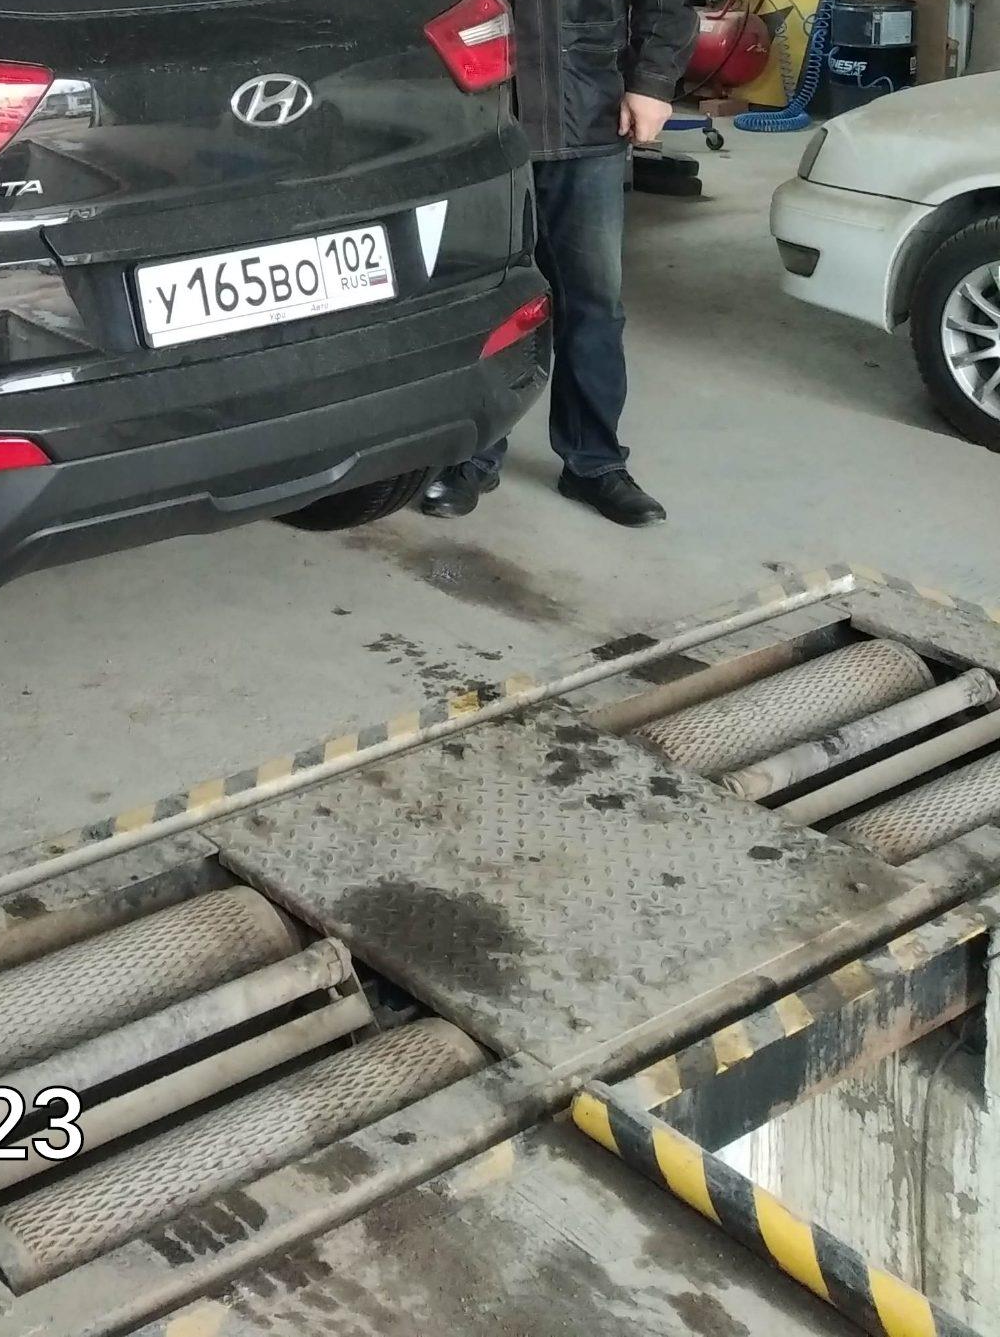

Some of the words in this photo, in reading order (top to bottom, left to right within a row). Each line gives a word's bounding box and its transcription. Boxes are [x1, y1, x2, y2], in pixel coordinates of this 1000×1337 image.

[156, 256, 320, 324] У165ВО
[325, 233, 380, 276] 102
[340, 273, 368, 290] RUS
